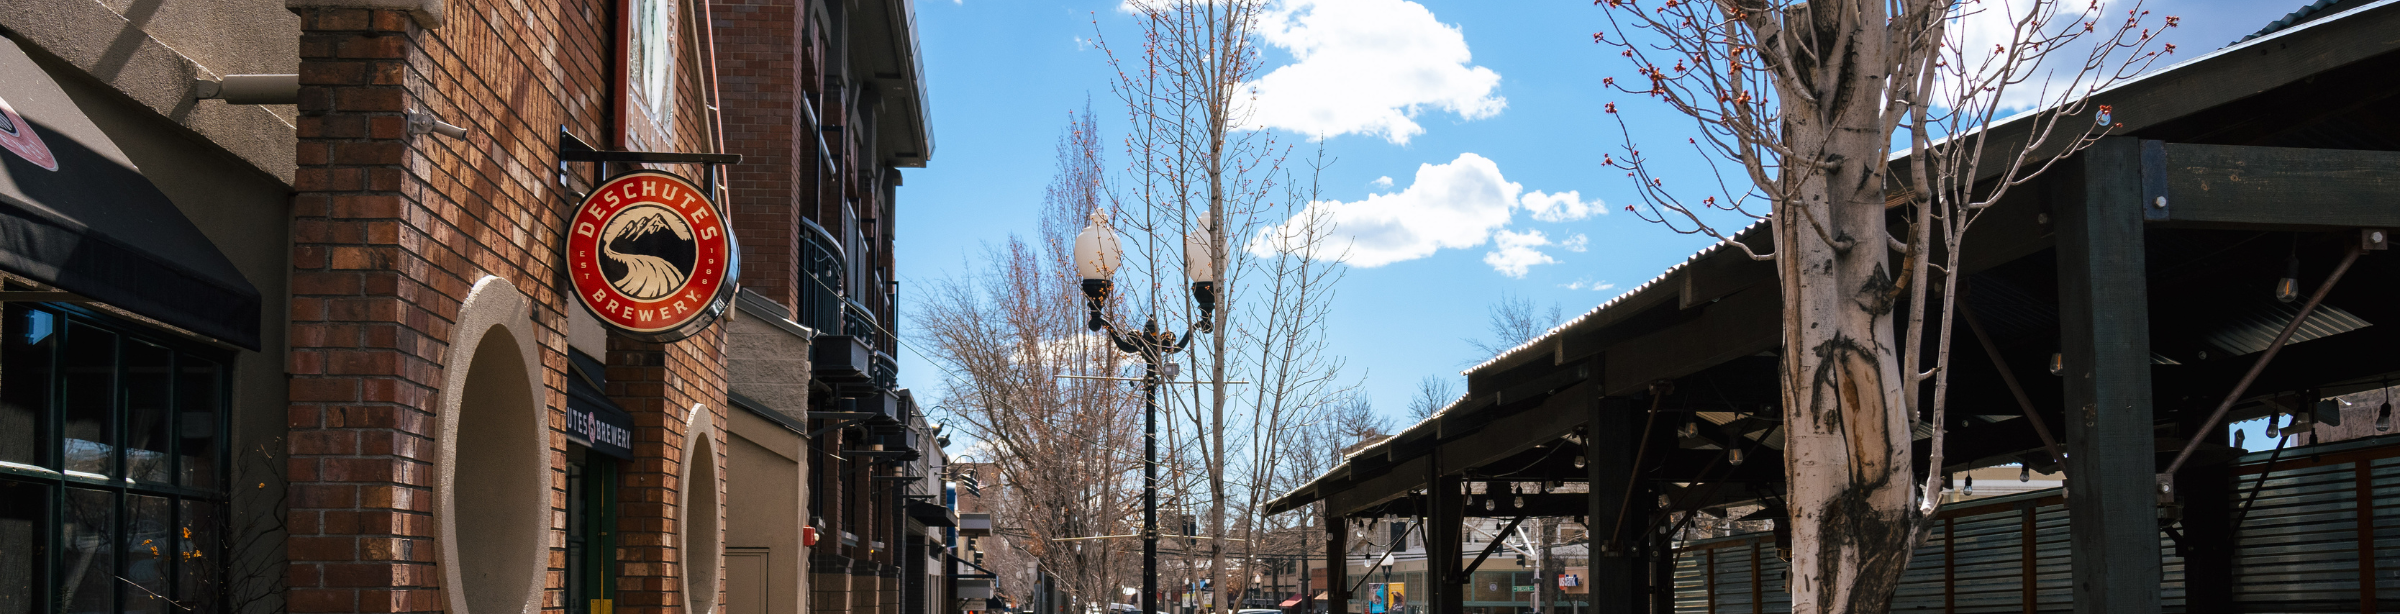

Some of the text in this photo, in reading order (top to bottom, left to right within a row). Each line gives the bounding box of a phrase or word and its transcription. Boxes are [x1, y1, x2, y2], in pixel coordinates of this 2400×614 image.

[577, 181, 718, 241] DESCHUTES
[579, 250, 590, 280] EST
[702, 247, 714, 285] 1988
